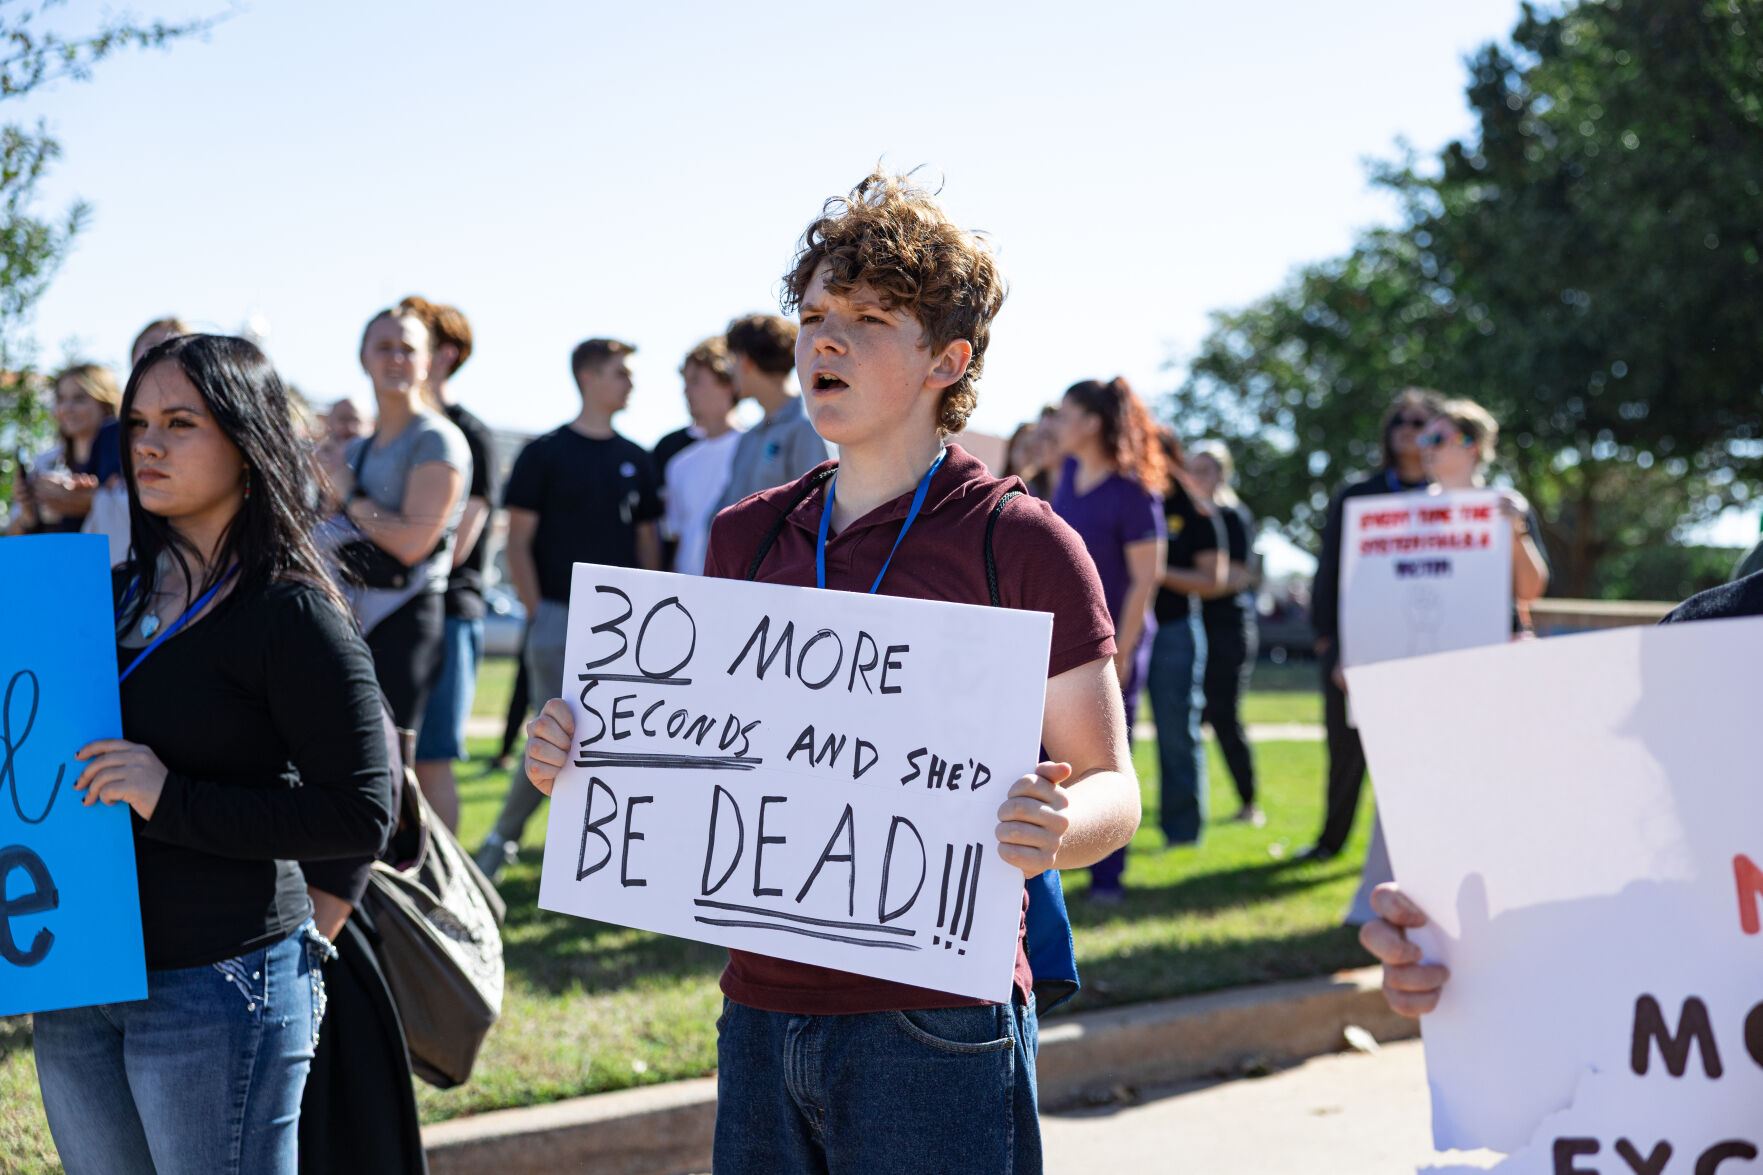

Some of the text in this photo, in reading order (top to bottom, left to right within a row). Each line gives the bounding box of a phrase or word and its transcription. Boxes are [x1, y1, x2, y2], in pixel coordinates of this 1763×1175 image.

[585, 584, 910, 695] 30 MORE
[579, 680, 992, 792] SECONDS AND SHE'D
[575, 776, 654, 888] BE
